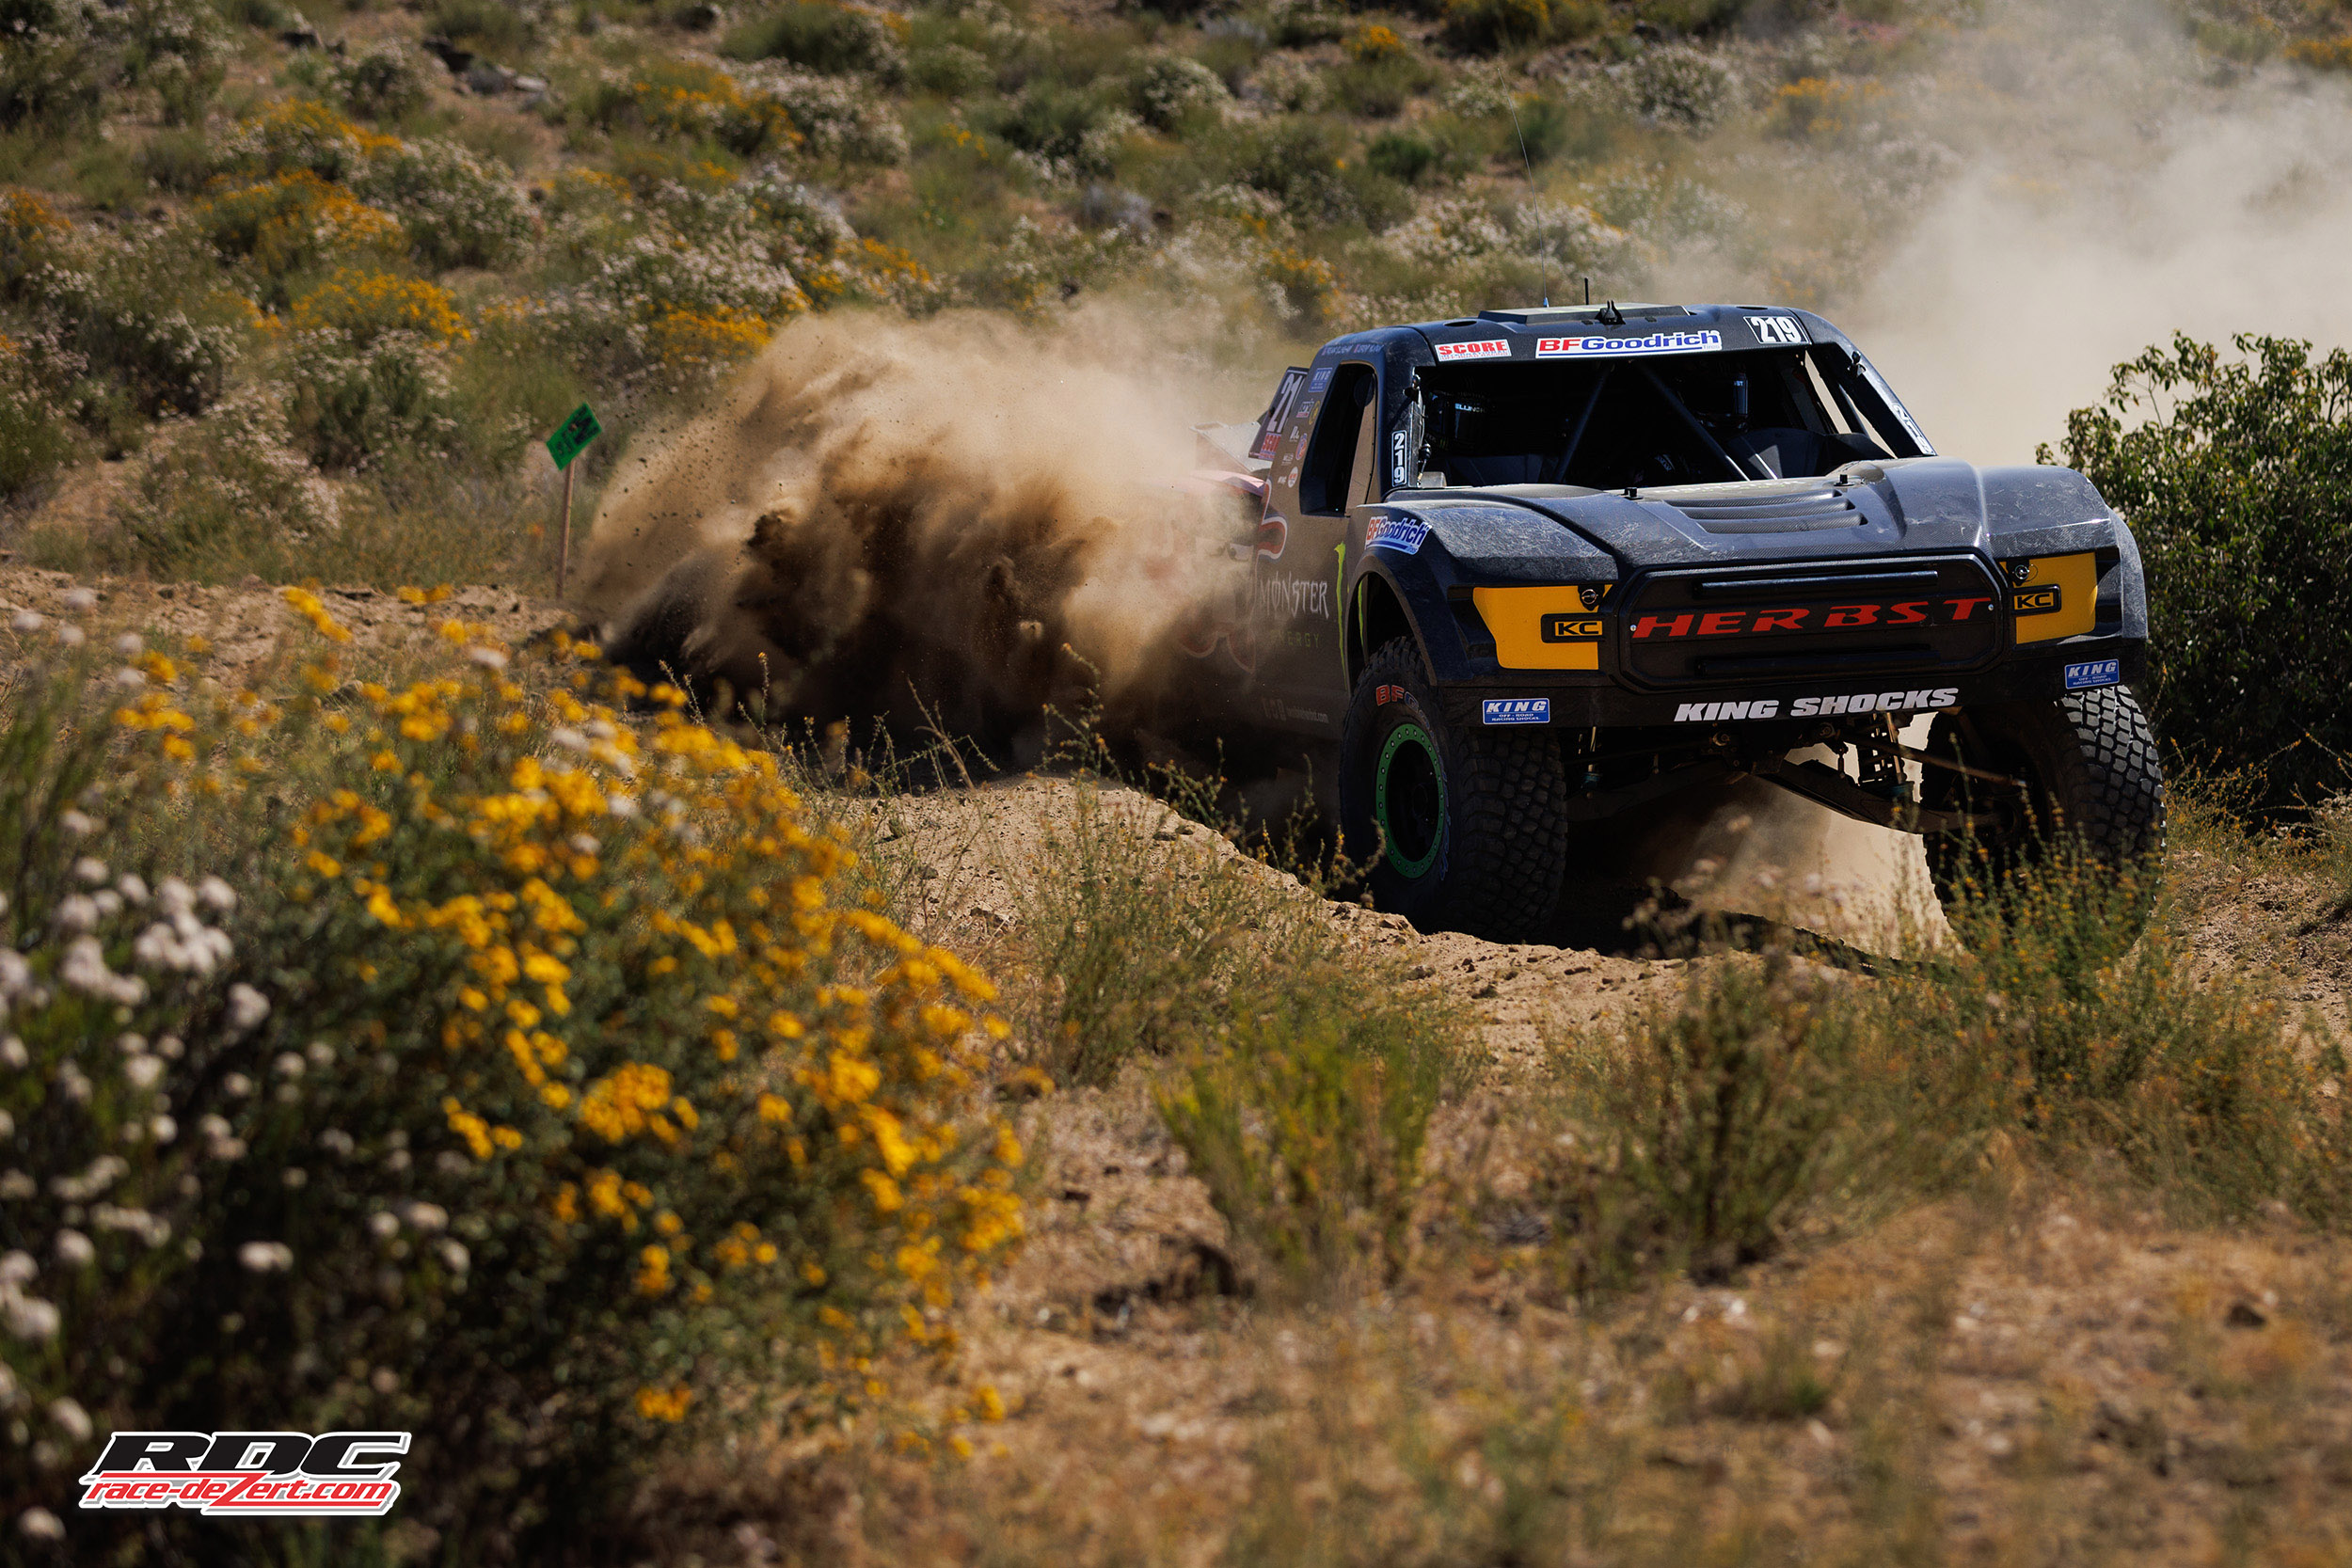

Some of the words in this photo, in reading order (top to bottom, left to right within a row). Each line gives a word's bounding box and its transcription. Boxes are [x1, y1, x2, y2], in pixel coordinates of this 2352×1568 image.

[1538, 332, 1719, 351] BFGoodrich
[1750, 316, 1802, 342] 219
[1438, 341, 1508, 356] SCORE
[1266, 373, 1306, 433] 21
[1393, 433, 1405, 483] 219
[1366, 517, 1429, 545] BFGoodrich
[1259, 570, 1329, 620] MONSTER
[2017, 594, 2052, 609] KC
[1557, 622, 1599, 635] KC
[1631, 597, 1992, 639] HERBST
[2068, 662, 2117, 677] KING
[1486, 701, 1548, 713] KING
[1673, 700, 1780, 722] KING
[1789, 688, 1959, 717] SHOCKS
